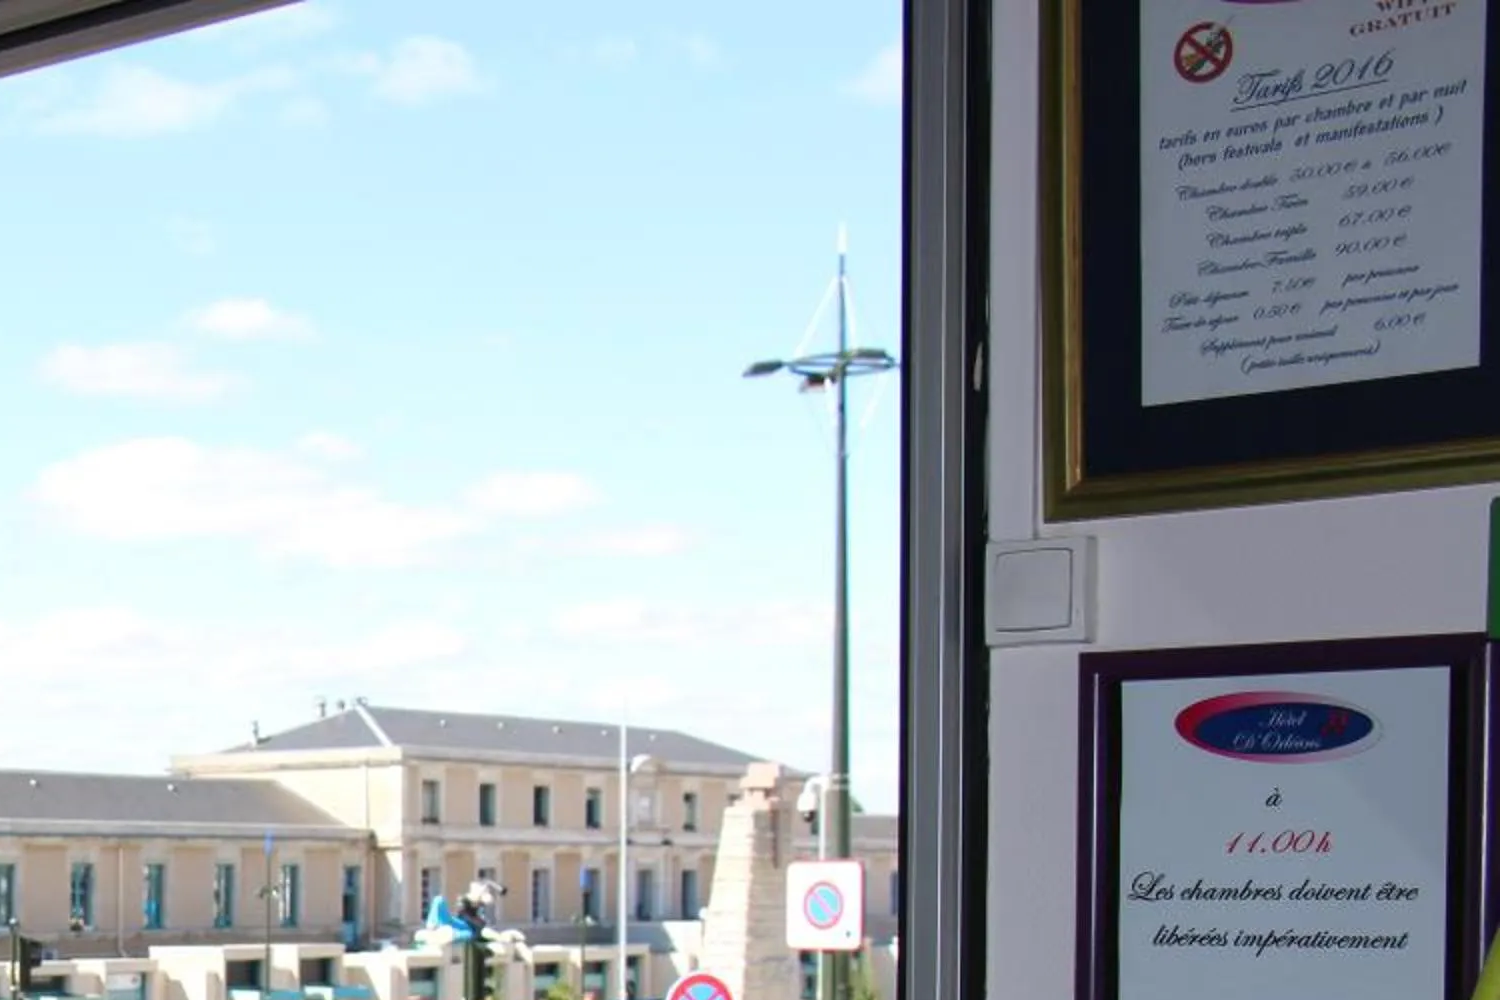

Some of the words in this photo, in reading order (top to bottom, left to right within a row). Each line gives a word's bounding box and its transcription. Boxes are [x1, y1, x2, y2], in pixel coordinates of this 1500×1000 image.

[1350, 2, 1457, 37] GRATUIT
[1232, 67, 1306, 104] Tarifs
[1311, 48, 1395, 89] 2016
[1159, 131, 1197, 150] tarifs
[1203, 129, 1221, 142] en
[1226, 121, 1268, 138] euros
[1274, 115, 1300, 136] par
[1305, 100, 1372, 123] chambre
[1379, 94, 1395, 108] et
[1399, 90, 1428, 109] par
[1433, 80, 1467, 97] nuit
[1223, 138, 1283, 161] festivals
[1294, 133, 1310, 146] et
[1265, 786, 1283, 808] à
[1127, 871, 1174, 902] Les
[1179, 879, 1282, 901] chambres
[1288, 877, 1372, 901] doivent
[1375, 881, 1419, 901] être
[1153, 924, 1229, 948] libérées
[1234, 928, 1409, 957] impérativement
